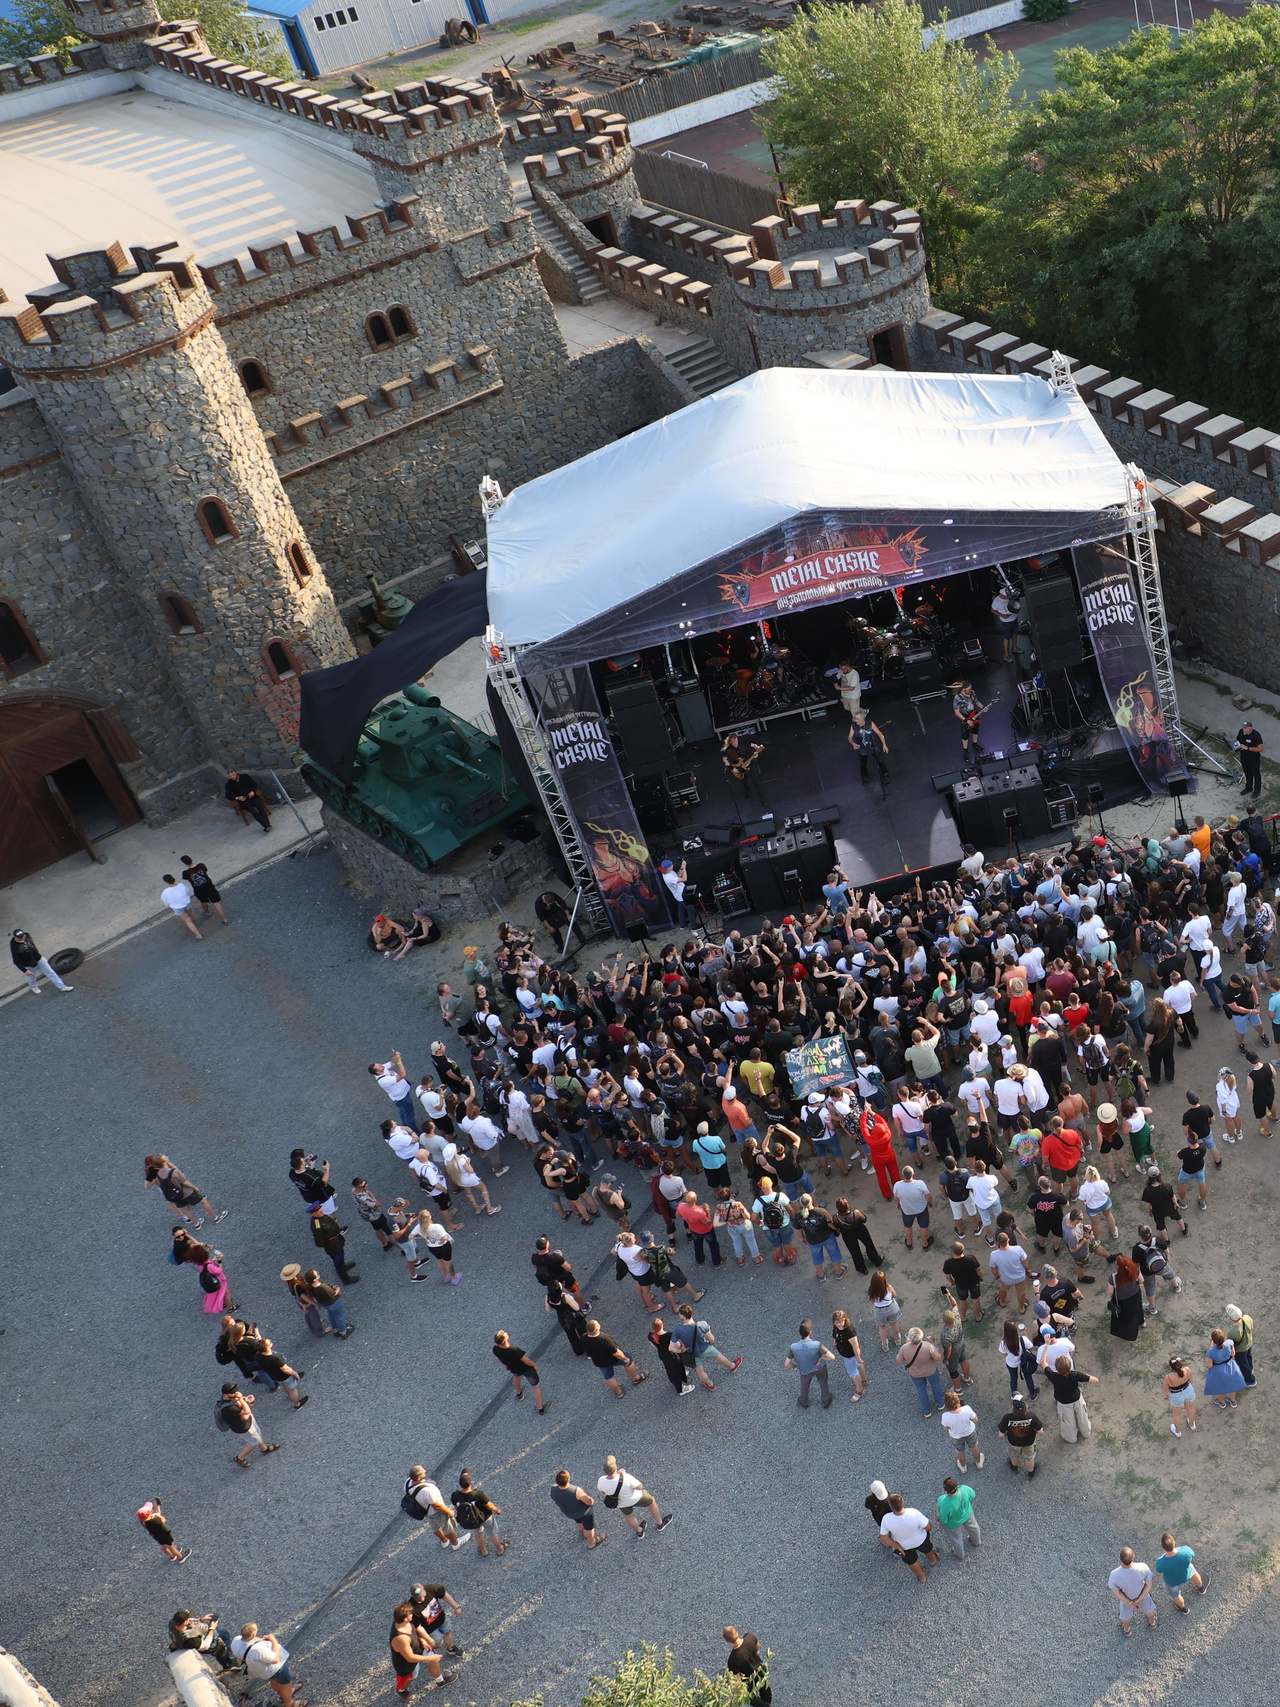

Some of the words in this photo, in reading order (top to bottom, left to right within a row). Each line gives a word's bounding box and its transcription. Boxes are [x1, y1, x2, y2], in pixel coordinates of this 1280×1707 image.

[769, 558, 829, 594] METAL
[823, 550, 881, 574] CASTLE
[1084, 582, 1138, 613] METAL
[1088, 604, 1136, 631] CASTLE
[550, 721, 611, 750] METAL
[555, 740, 609, 769] CASTLE
